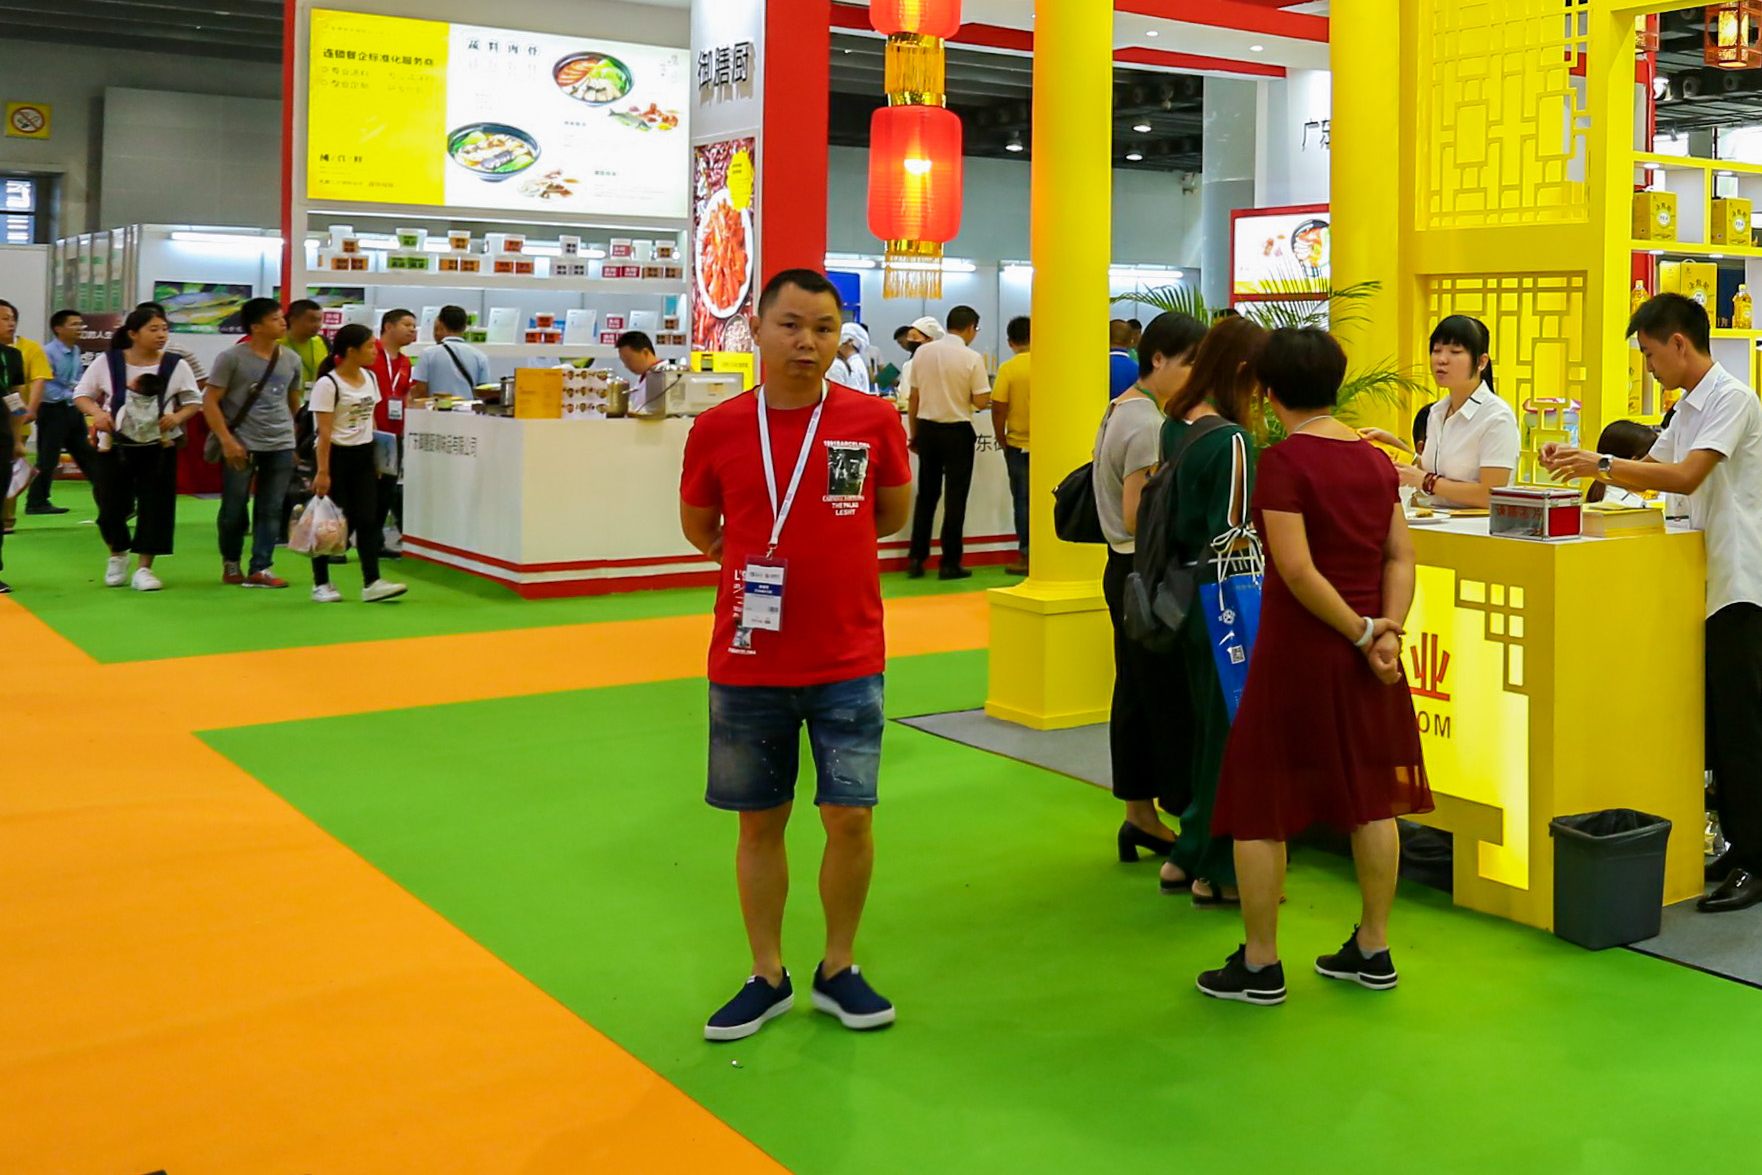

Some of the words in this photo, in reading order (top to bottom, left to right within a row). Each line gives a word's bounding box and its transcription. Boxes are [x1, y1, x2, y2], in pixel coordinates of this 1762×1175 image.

[697, 41, 750, 92] 御膳厨
[1410, 632, 1450, 702] 业
